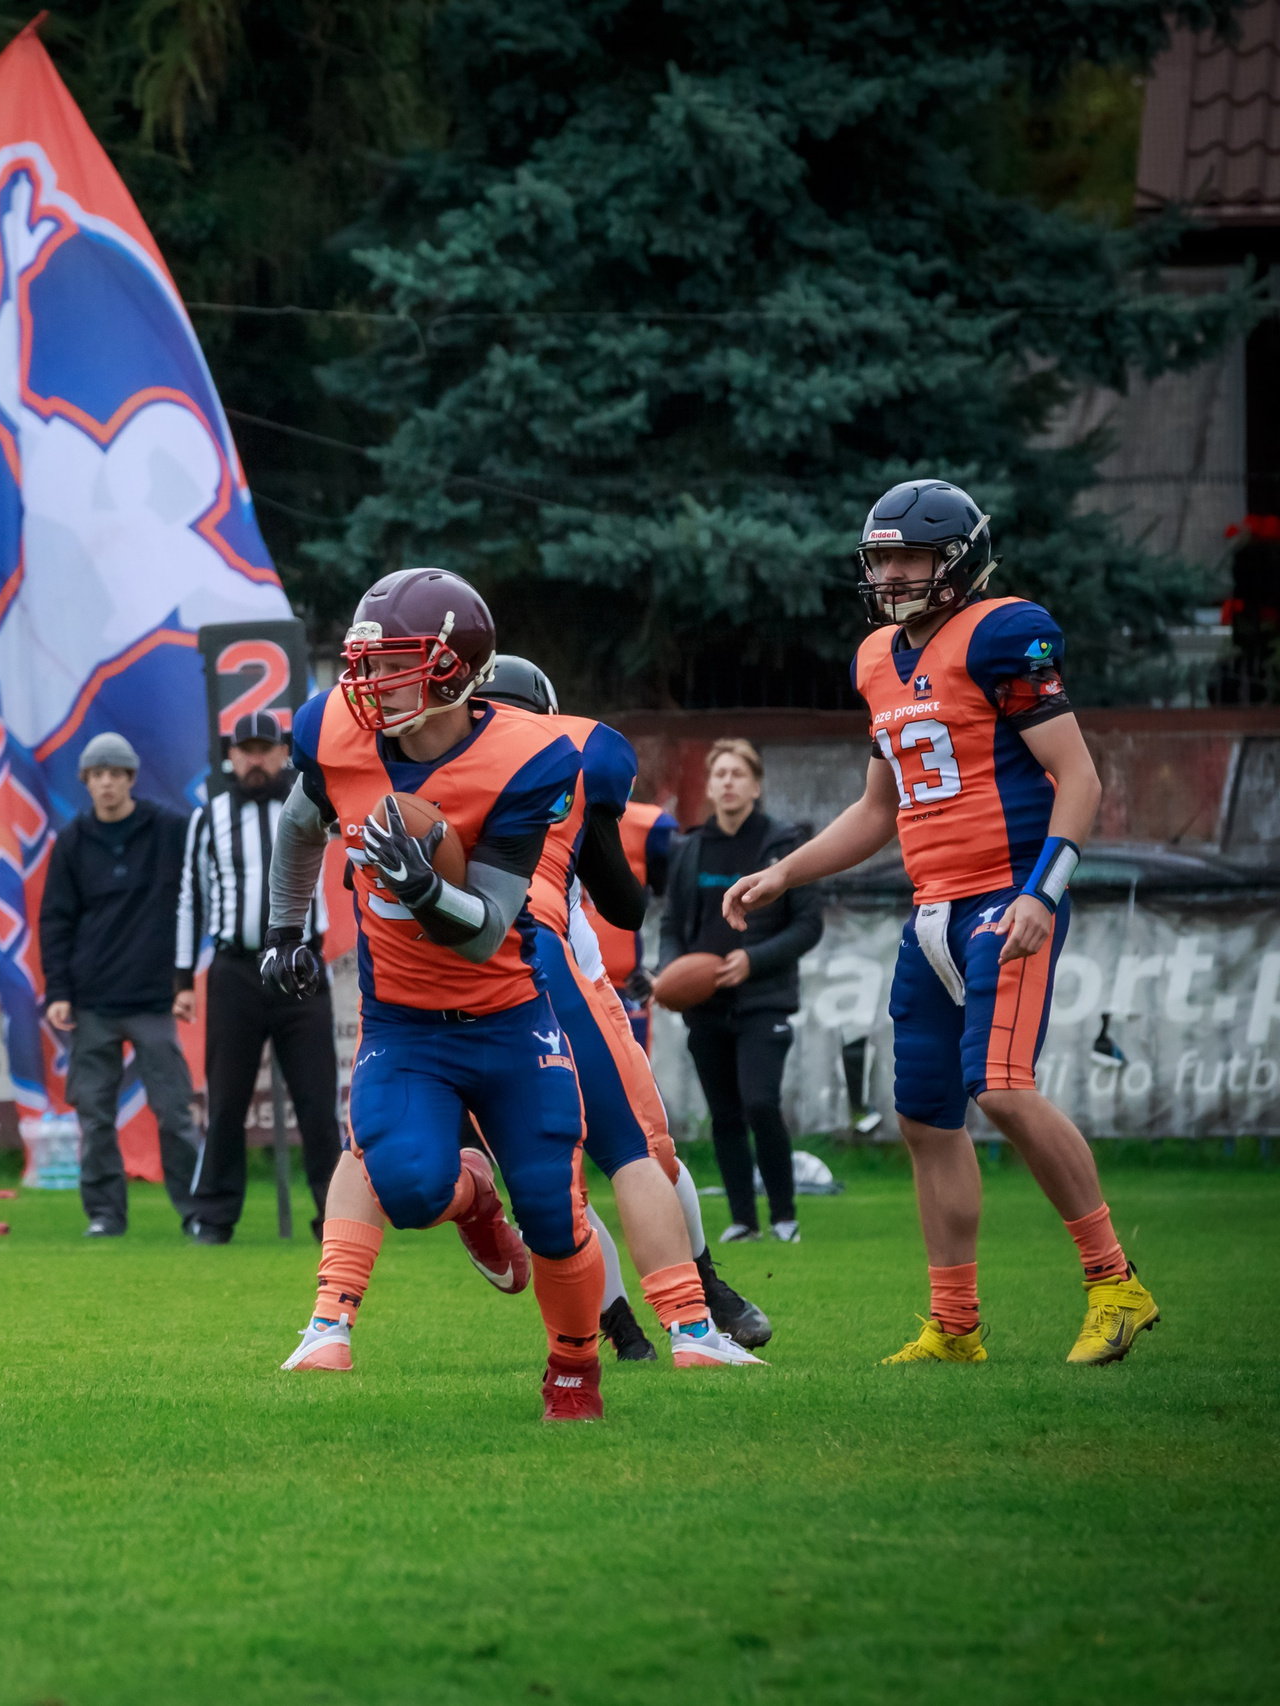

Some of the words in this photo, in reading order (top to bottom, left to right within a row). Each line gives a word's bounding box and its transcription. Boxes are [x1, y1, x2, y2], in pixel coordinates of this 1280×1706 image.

[870, 531, 897, 539] Riddell
[216, 640, 293, 736] 2
[894, 701, 940, 721] projekt
[875, 718, 963, 810] 13
[554, 1375, 583, 1388] NIKE
